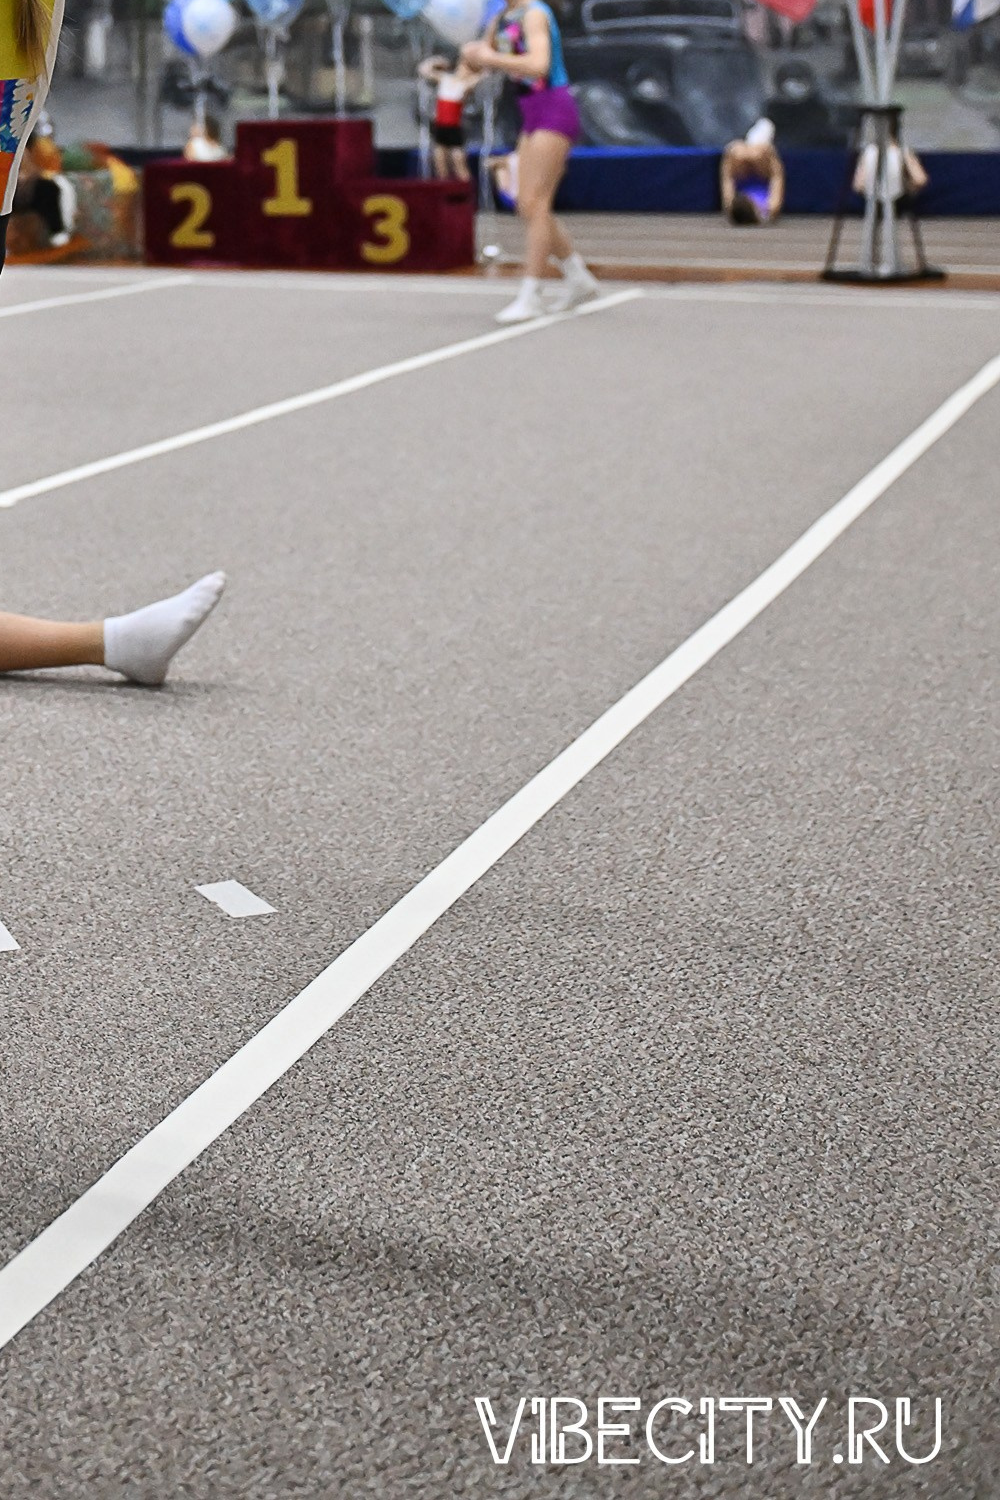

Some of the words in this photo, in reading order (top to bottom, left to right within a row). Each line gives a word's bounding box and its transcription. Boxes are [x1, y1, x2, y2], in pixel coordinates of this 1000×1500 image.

[262, 138, 313, 217] 1
[169, 182, 216, 248] 2
[360, 194, 410, 264] 3
